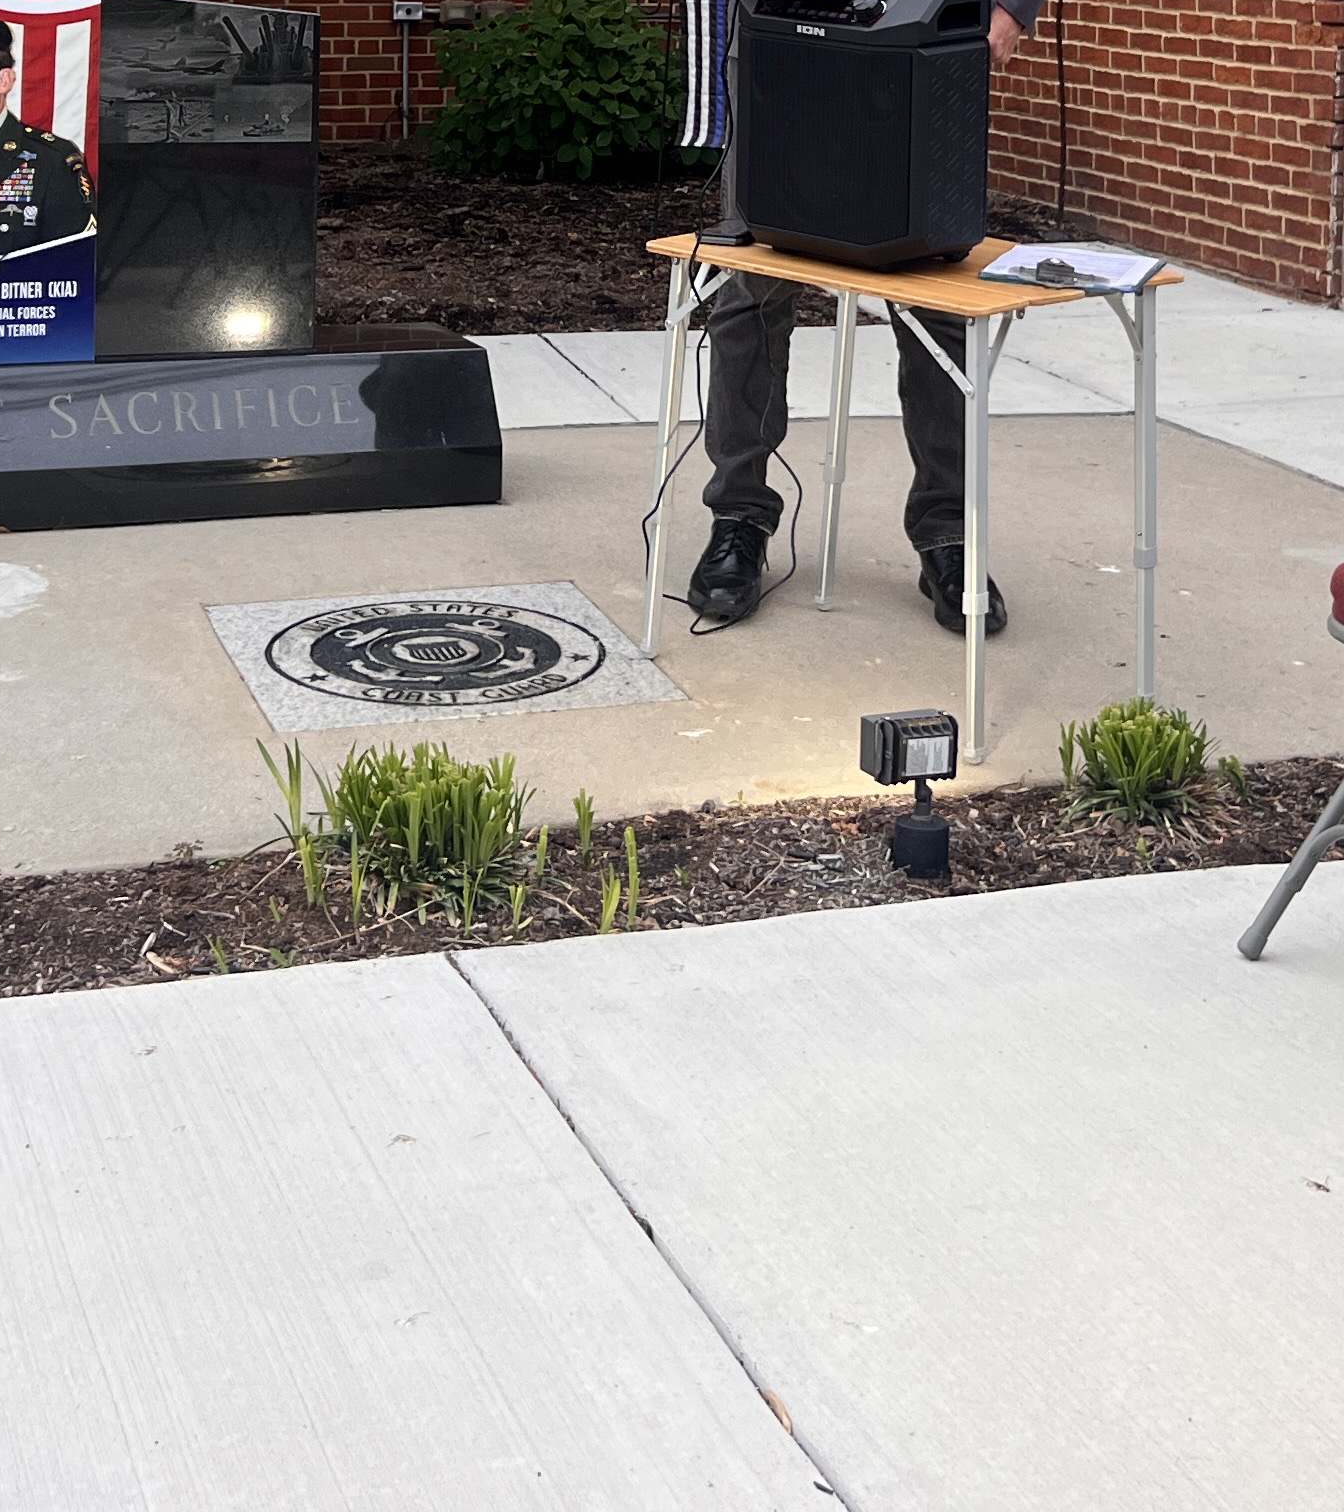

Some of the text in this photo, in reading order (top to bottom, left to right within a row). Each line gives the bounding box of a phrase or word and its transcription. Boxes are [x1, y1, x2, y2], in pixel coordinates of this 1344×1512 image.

[796, 24, 826, 37] ION
[1, 281, 43, 300] BITNER
[48, 280, 78, 298] (KIA)
[17, 305, 56, 320] FORCES
[7, 323, 47, 337] TERROR
[47, 383, 360, 439] SACRIFICE
[301, 603, 521, 634] UNITED STATES
[361, 673, 568, 704] COAST GUARD
